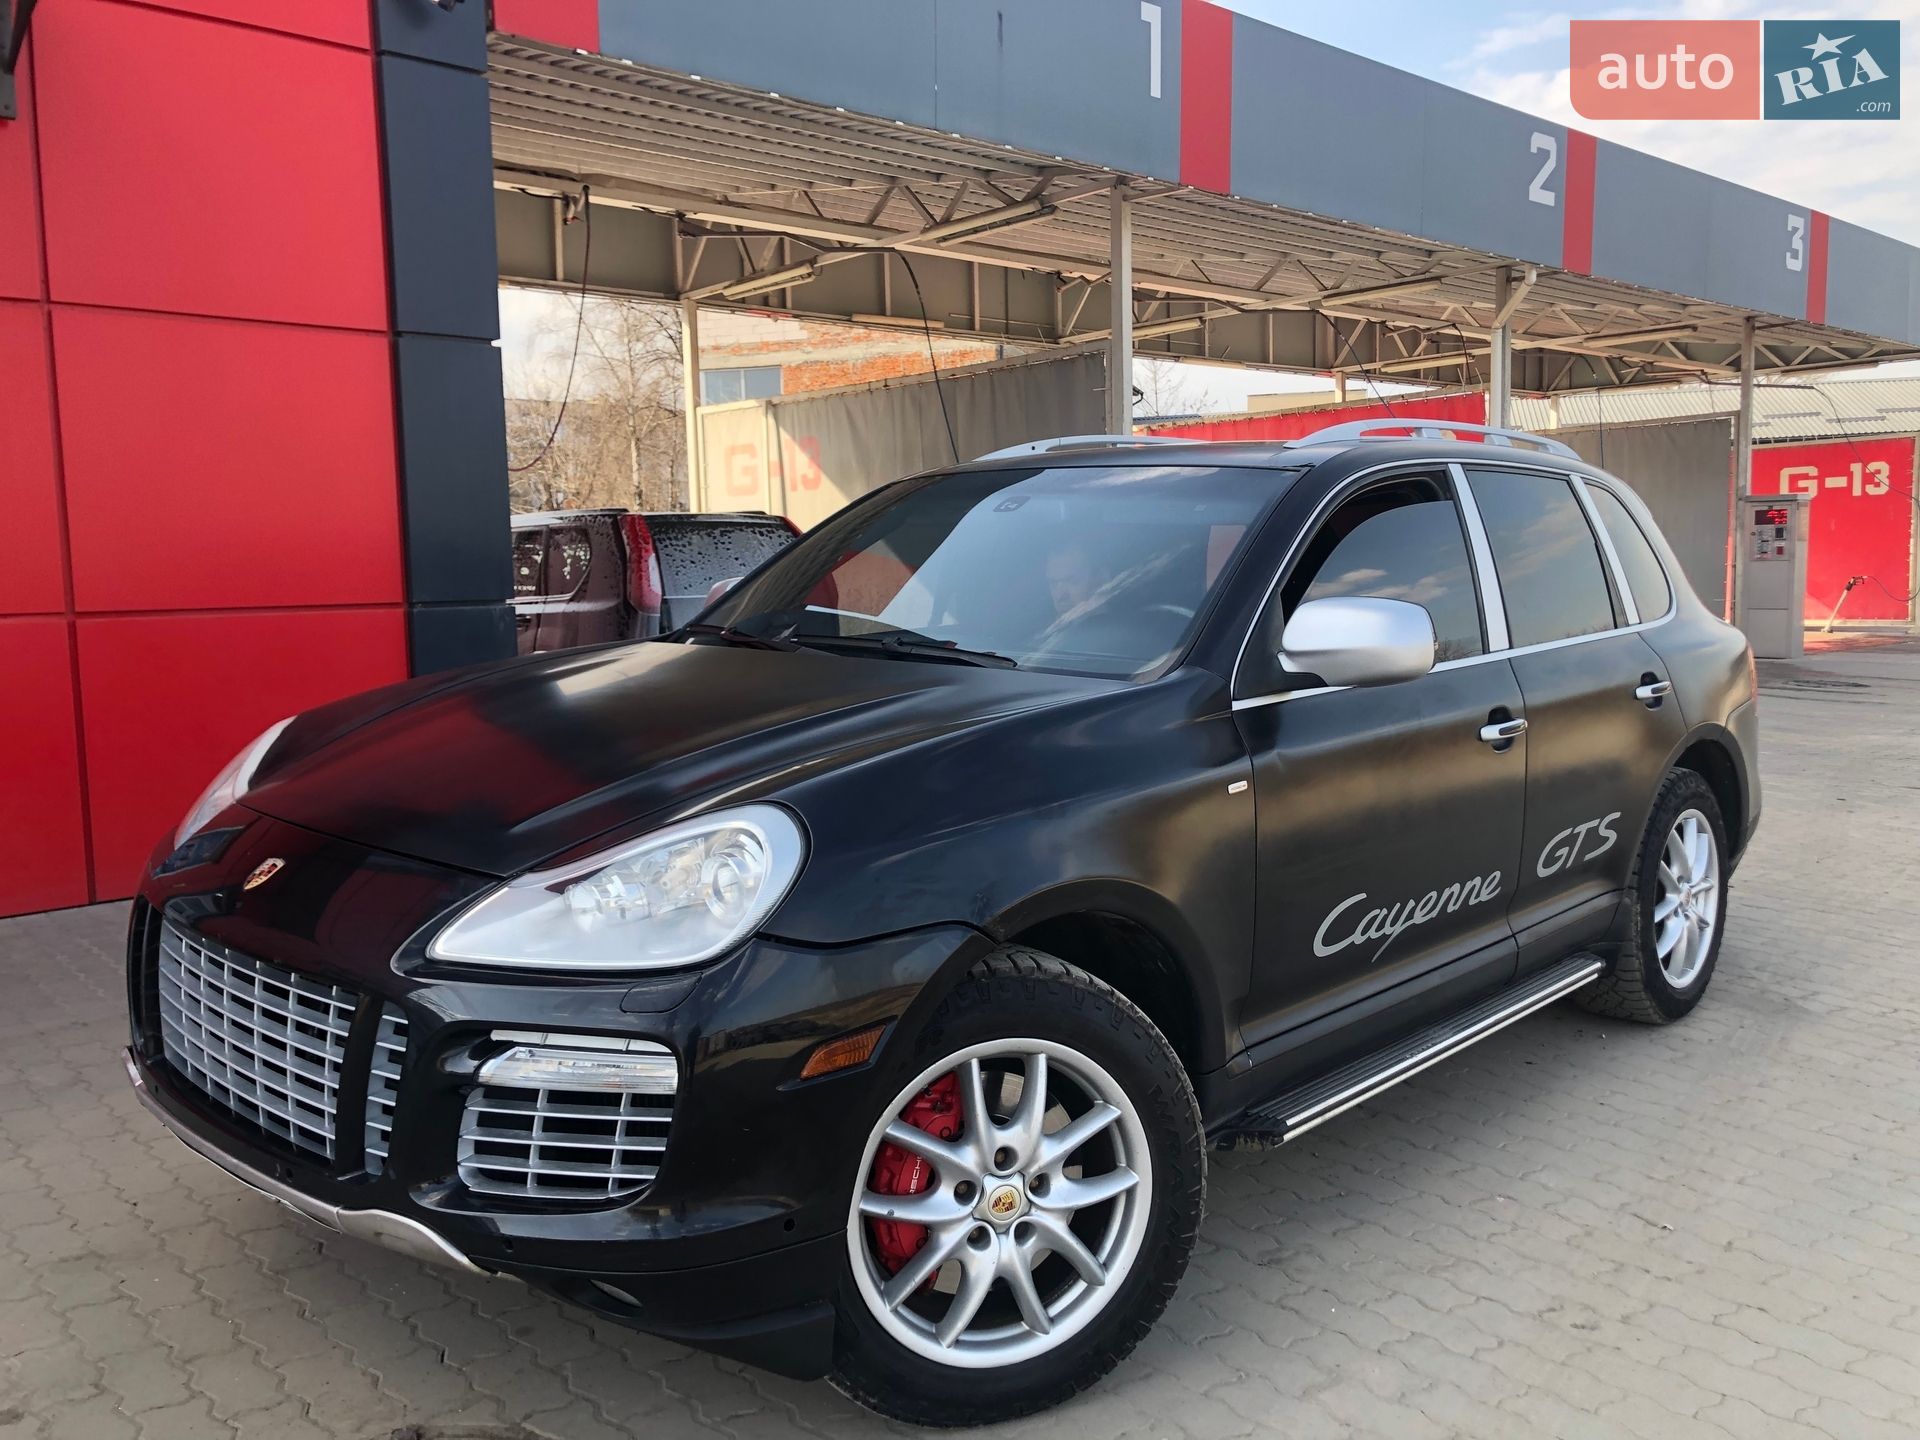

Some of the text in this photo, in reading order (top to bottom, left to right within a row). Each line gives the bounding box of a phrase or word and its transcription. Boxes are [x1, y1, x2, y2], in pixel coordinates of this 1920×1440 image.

[1141, 1, 1161, 98] 1
[1529, 131, 1557, 206] 2
[1785, 214, 1804, 271] 3
[724, 435, 822, 497] G-13
[1779, 461, 1890, 499] G-13
[1313, 811, 1621, 963] Cayenne GTS
